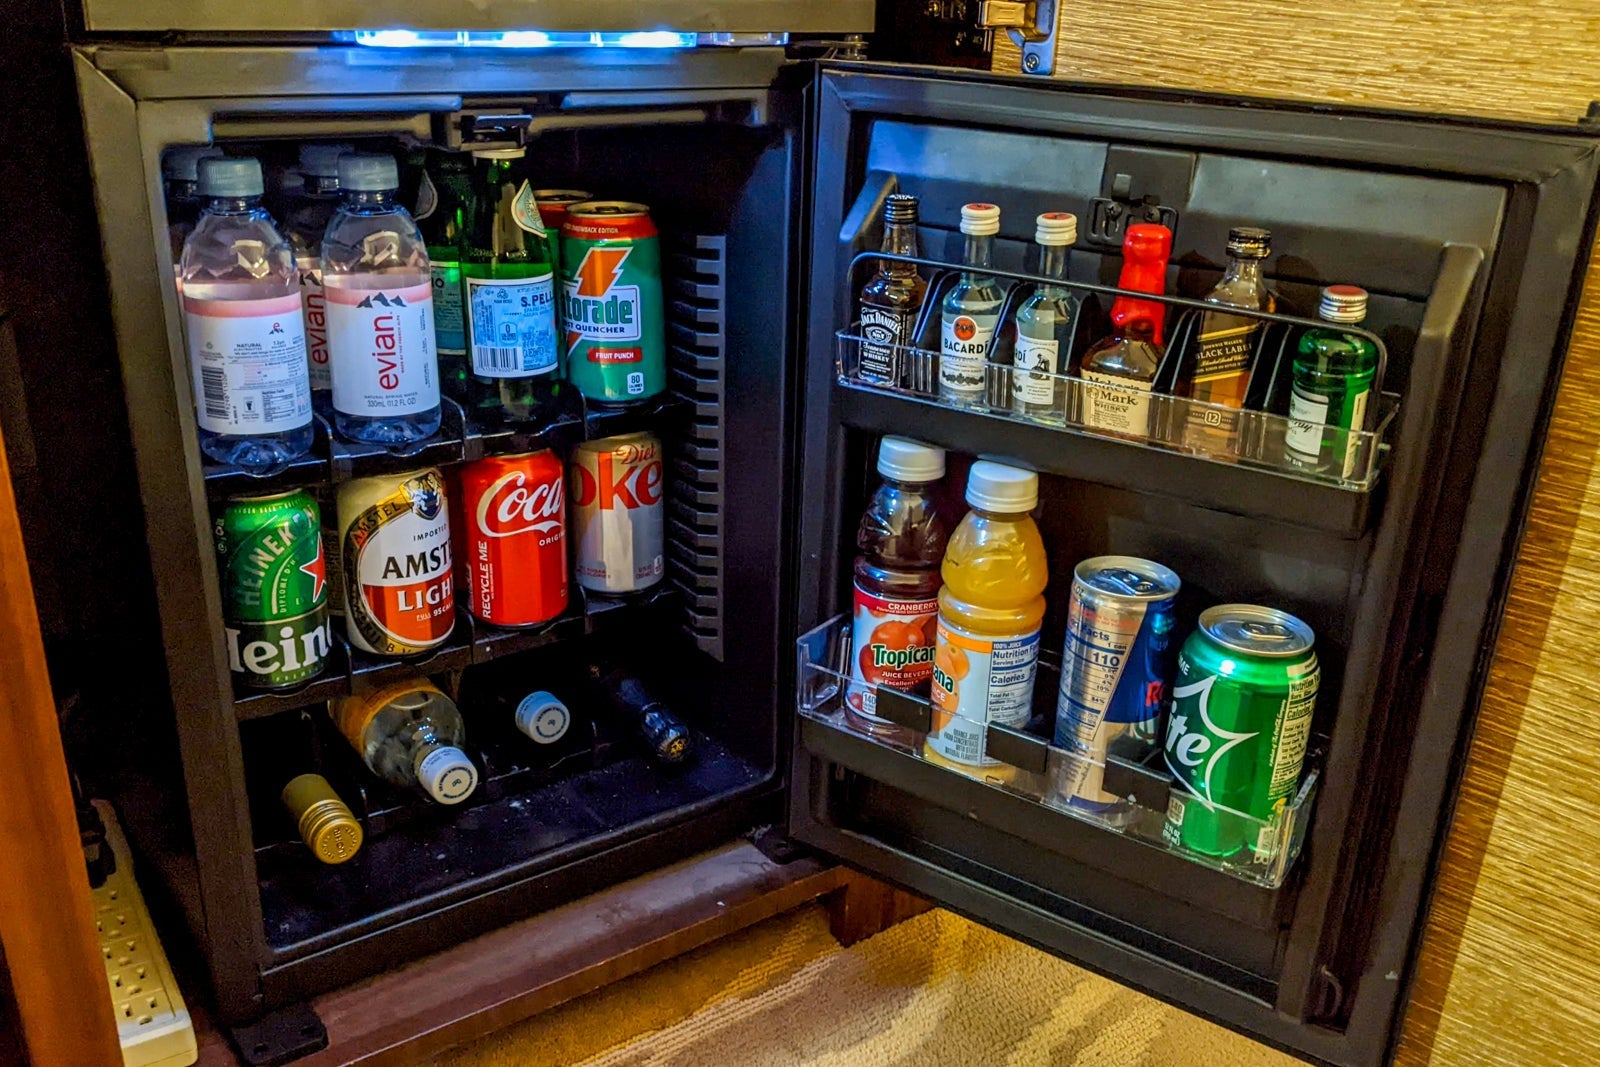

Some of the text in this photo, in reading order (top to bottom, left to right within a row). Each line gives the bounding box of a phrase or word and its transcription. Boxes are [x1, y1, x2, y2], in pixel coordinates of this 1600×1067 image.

[562, 290, 633, 324] torade
[506, 324, 510, 334] 0
[576, 324, 625, 333] QUENCHER
[861, 312, 902, 335] JACK DANIEL'S
[306, 294, 329, 365] evian
[372, 315, 400, 390] evian
[863, 352, 890, 362] WHISKEY
[1196, 349, 1222, 360] BLACK
[631, 374, 641, 384] 80
[1100, 390, 1138, 406] Mark
[1208, 412, 1218, 423] 12
[615, 442, 655, 464] Diet
[352, 501, 401, 545] AMSTEL
[478, 540, 491, 618] RECYCLE ME
[433, 608, 442, 617] 95
[888, 602, 937, 612] CRANBERRY
[1008, 641, 1022, 649] JUICE
[993, 648, 1028, 659] Nutrition
[1092, 652, 1120, 667] 110
[991, 674, 1025, 684] Calories
[1291, 678, 1314, 692] Nutrition
[864, 692, 876, 704] 140
[944, 731, 954, 740] FROM
[956, 744, 966, 752] WITH
